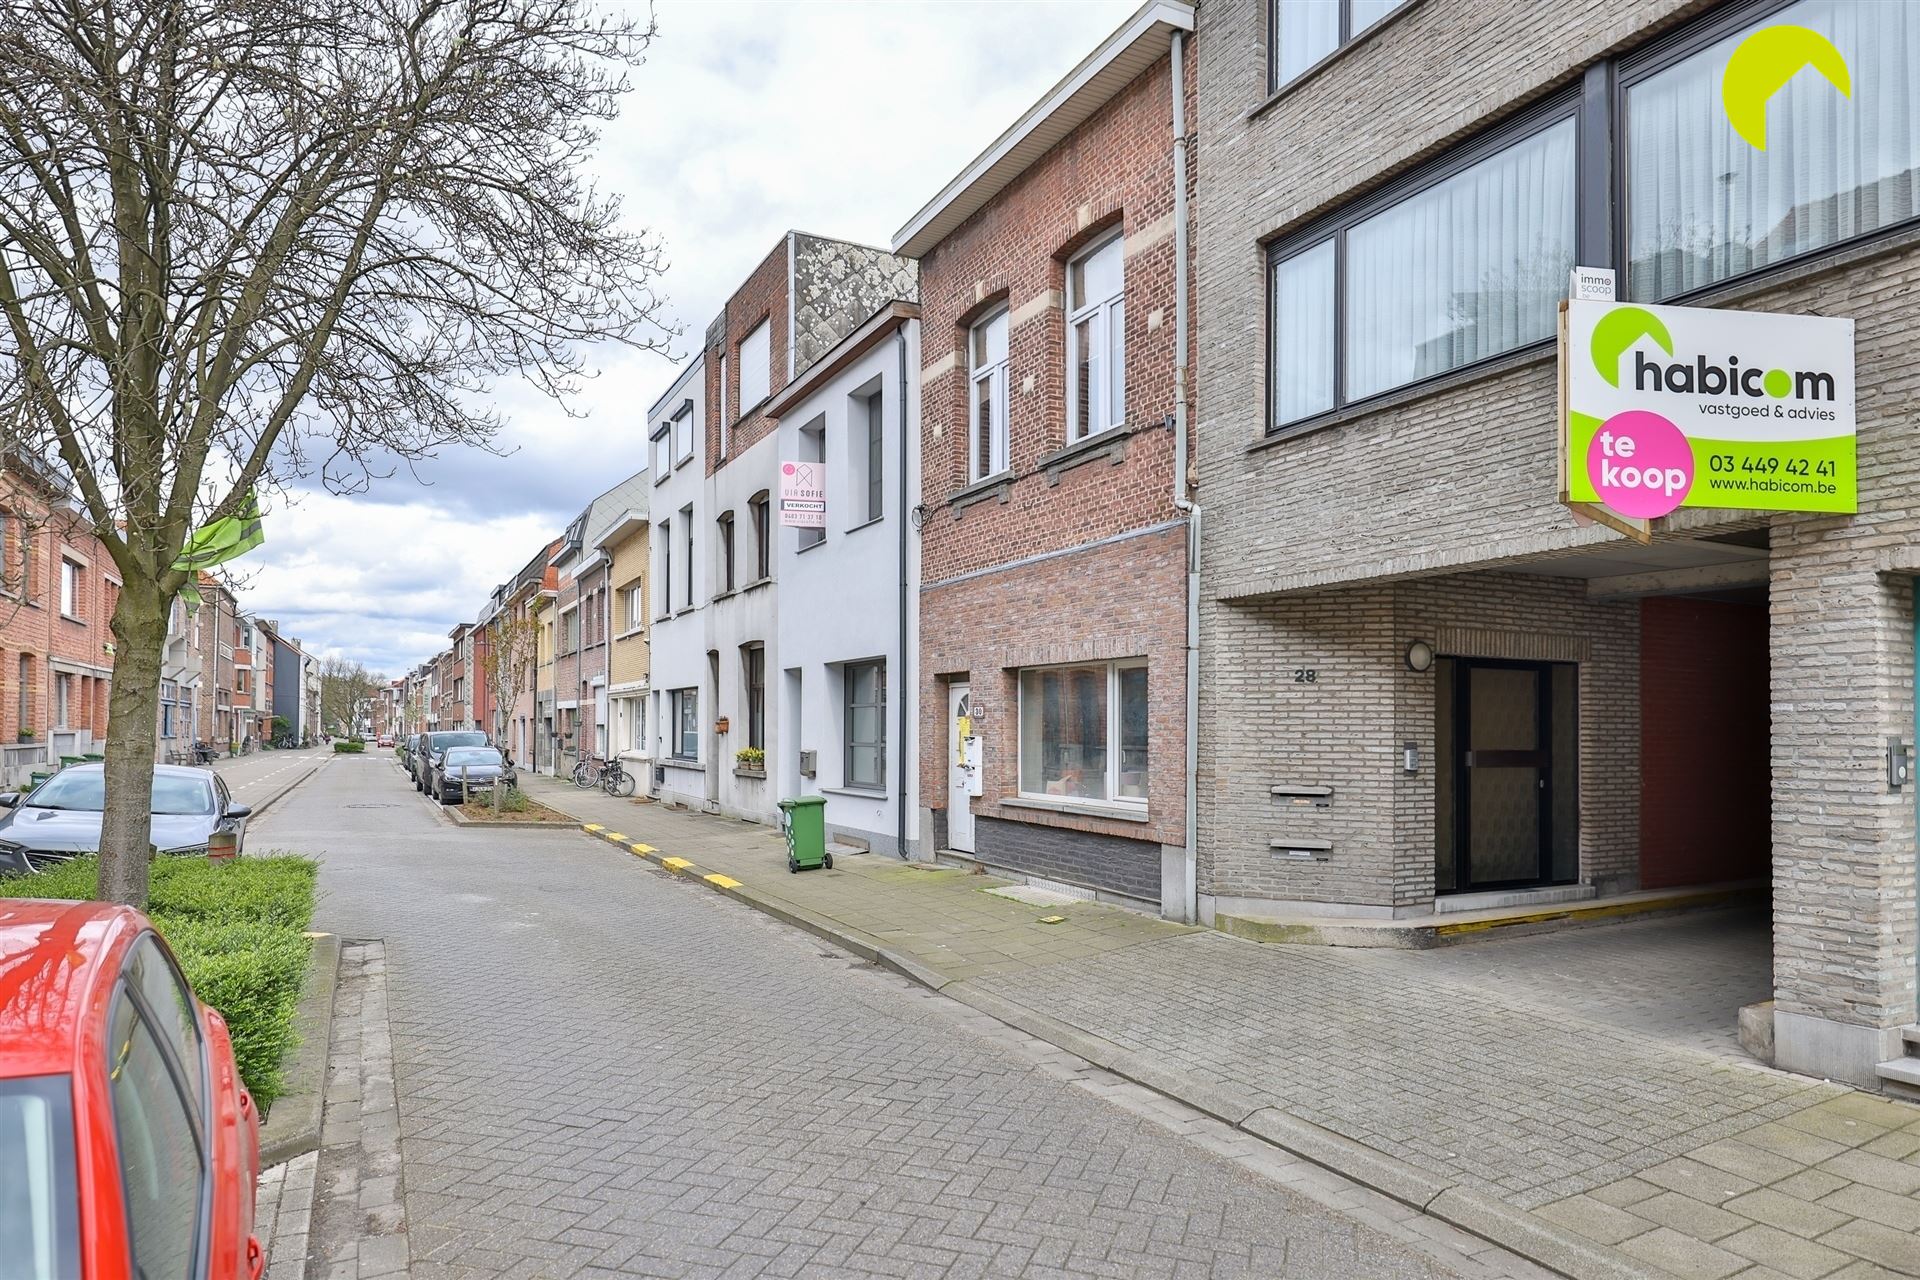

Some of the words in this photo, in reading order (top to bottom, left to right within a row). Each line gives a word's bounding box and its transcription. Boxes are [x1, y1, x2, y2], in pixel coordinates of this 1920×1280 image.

[1581, 273, 1612, 286] immo
[1581, 285, 1612, 296] scoop
[1635, 351, 1836, 401] habicom
[1699, 403, 1770, 419] vastgoed
[1774, 405, 1784, 418] &
[1787, 407, 1836, 421] advies
[1600, 430, 1636, 458] te
[1709, 454, 1735, 473] 03
[1741, 456, 1779, 474] 449
[1785, 458, 1809, 476] 42
[1816, 460, 1835, 477] 41
[1601, 458, 1687, 496] koop
[800, 489, 824, 498] SOFIE
[1710, 478, 1837, 494] www.habicom.be
[1294, 669, 1317, 683] 28
